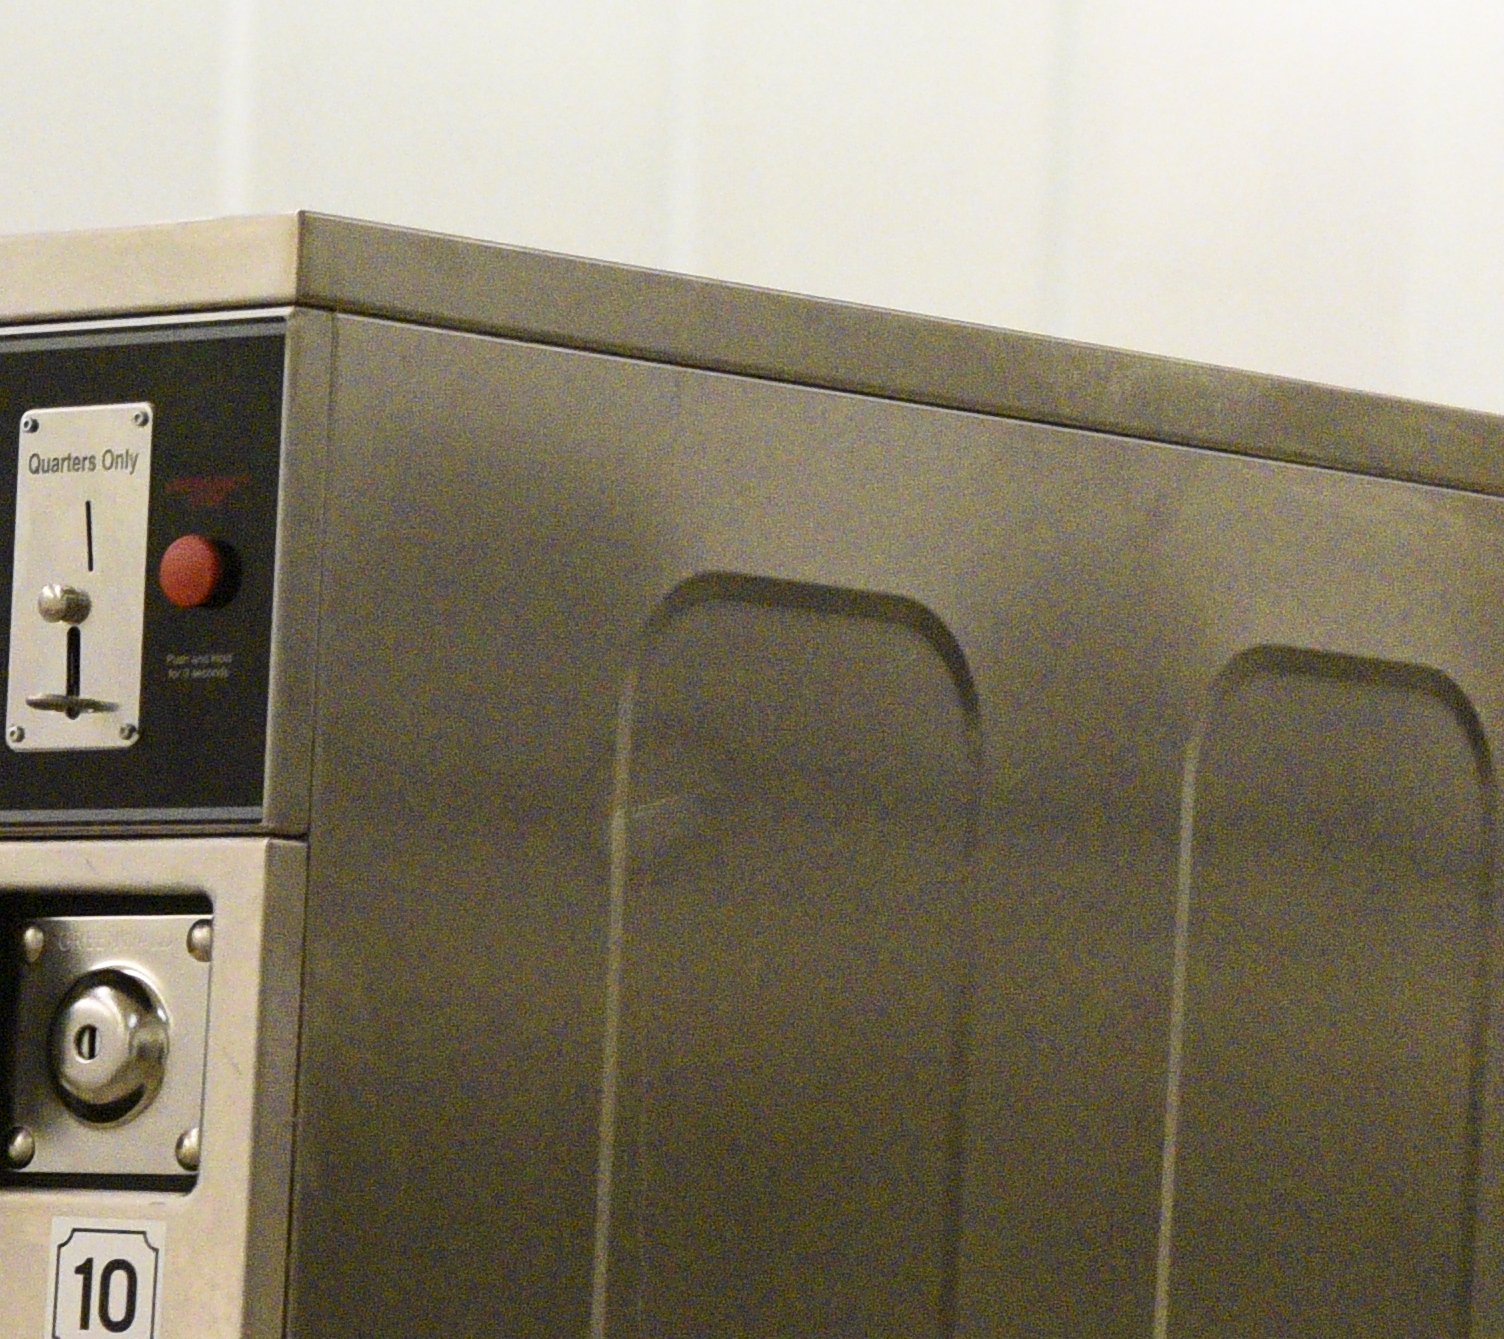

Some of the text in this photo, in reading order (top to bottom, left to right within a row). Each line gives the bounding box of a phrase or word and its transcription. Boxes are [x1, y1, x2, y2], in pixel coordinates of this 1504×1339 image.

[28, 448, 140, 476] Quarters Only
[74, 1256, 138, 1333] 10
